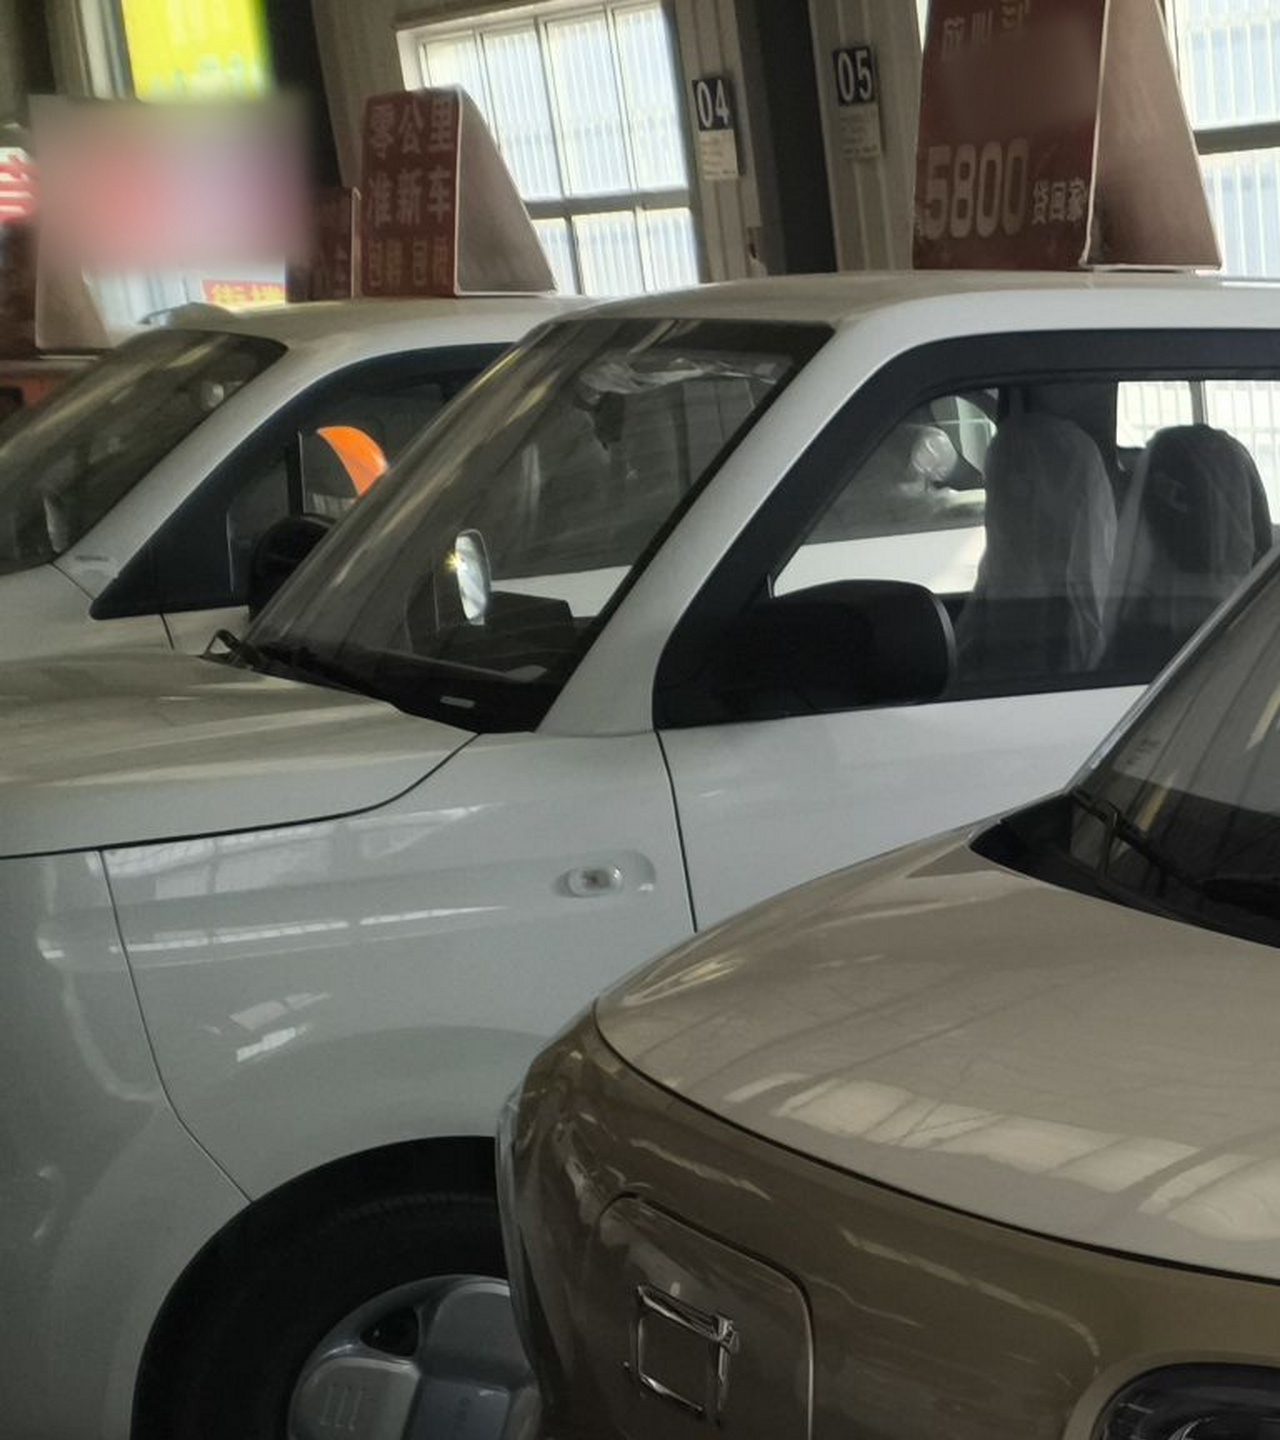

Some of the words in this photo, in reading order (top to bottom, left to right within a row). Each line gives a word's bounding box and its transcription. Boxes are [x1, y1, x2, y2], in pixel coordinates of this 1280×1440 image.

[695, 78, 731, 129] 04
[836, 49, 874, 103] 05
[368, 94, 455, 160] 零公里
[366, 165, 453, 229] 准新车
[921, 136, 1030, 241] 5800
